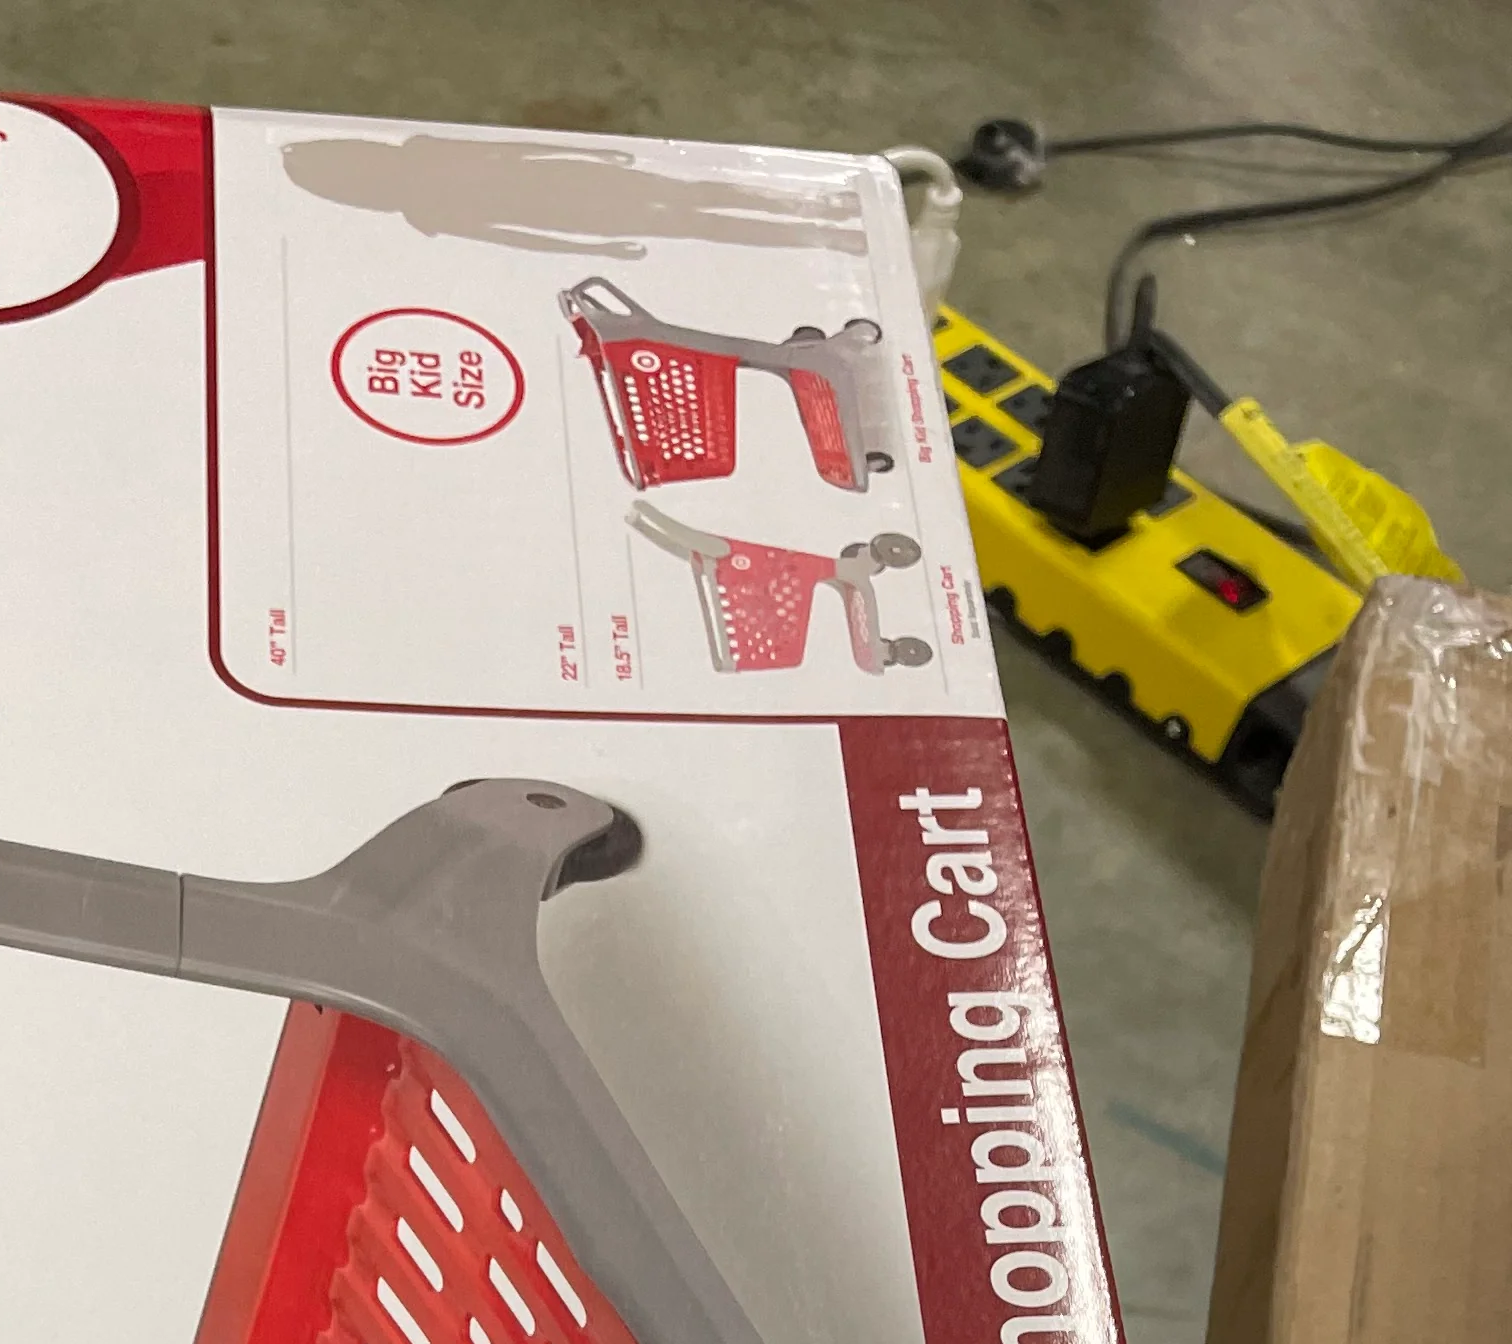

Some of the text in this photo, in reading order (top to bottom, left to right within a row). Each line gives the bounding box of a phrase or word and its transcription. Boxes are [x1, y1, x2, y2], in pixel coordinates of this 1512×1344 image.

[367, 350, 407, 394] Big
[412, 352, 440, 398] Kid
[455, 350, 485, 410] Size
[269, 609, 286, 635] Tall
[939, 565, 966, 645] Shopping Cart
[558, 625, 575, 651] Tall
[612, 615, 629, 641] Tall
[898, 785, 1007, 962] Cart
